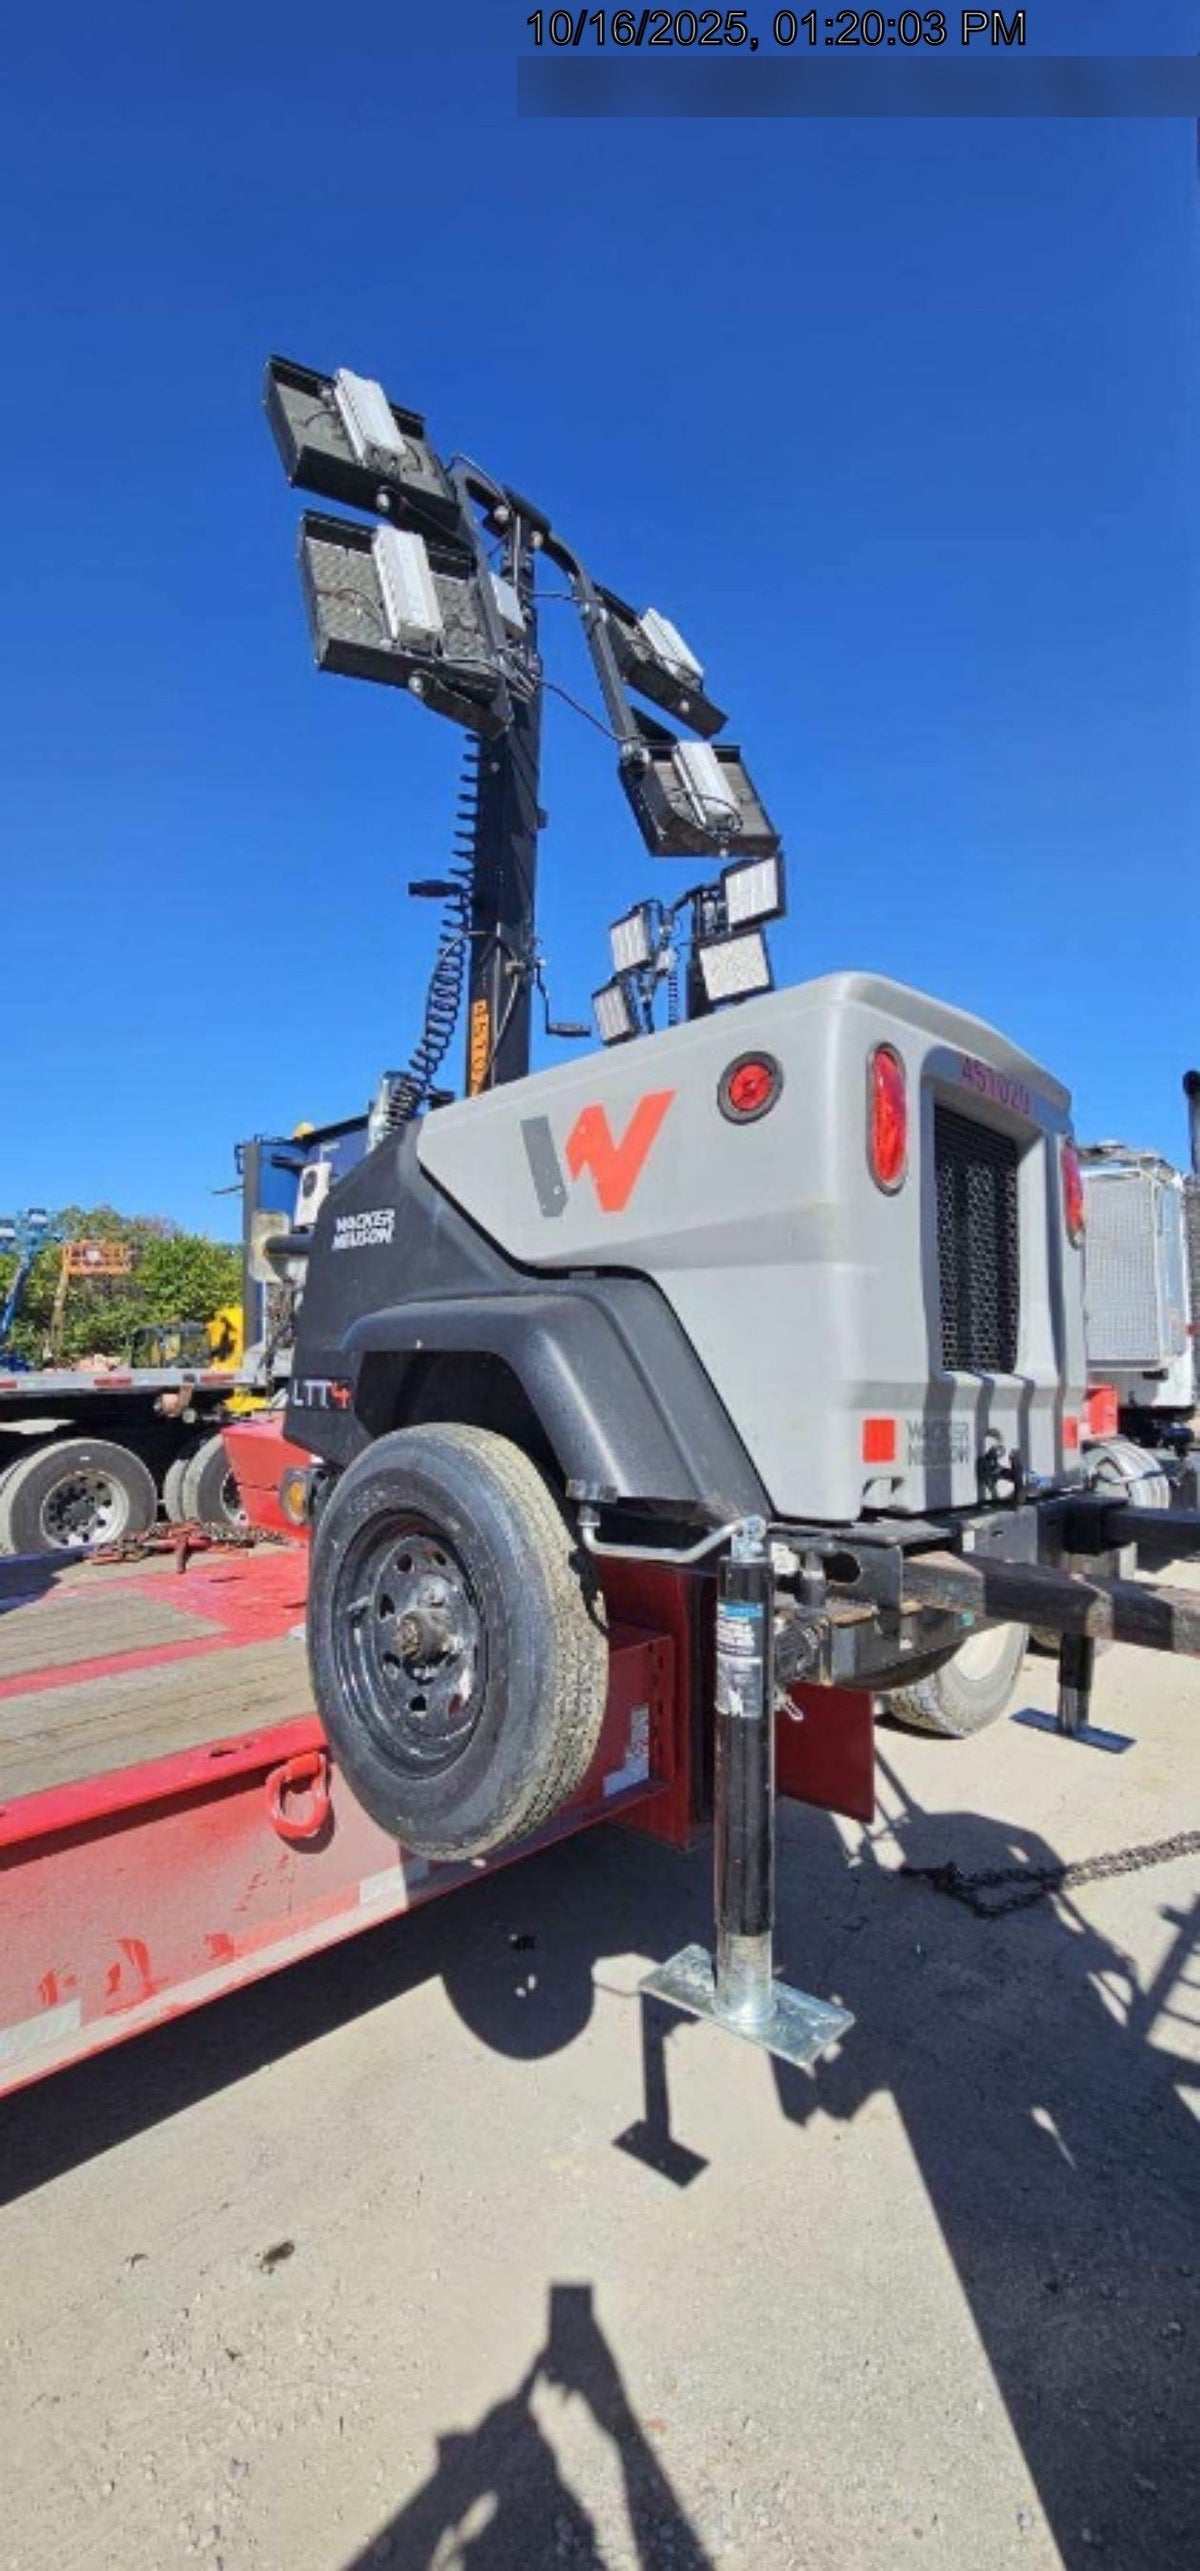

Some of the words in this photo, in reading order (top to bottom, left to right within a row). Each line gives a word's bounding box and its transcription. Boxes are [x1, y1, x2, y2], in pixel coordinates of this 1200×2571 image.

[336, 1208, 396, 1233] WACKER
[331, 1228, 394, 1251] NEUSON
[293, 1380, 351, 1409] LTT4
